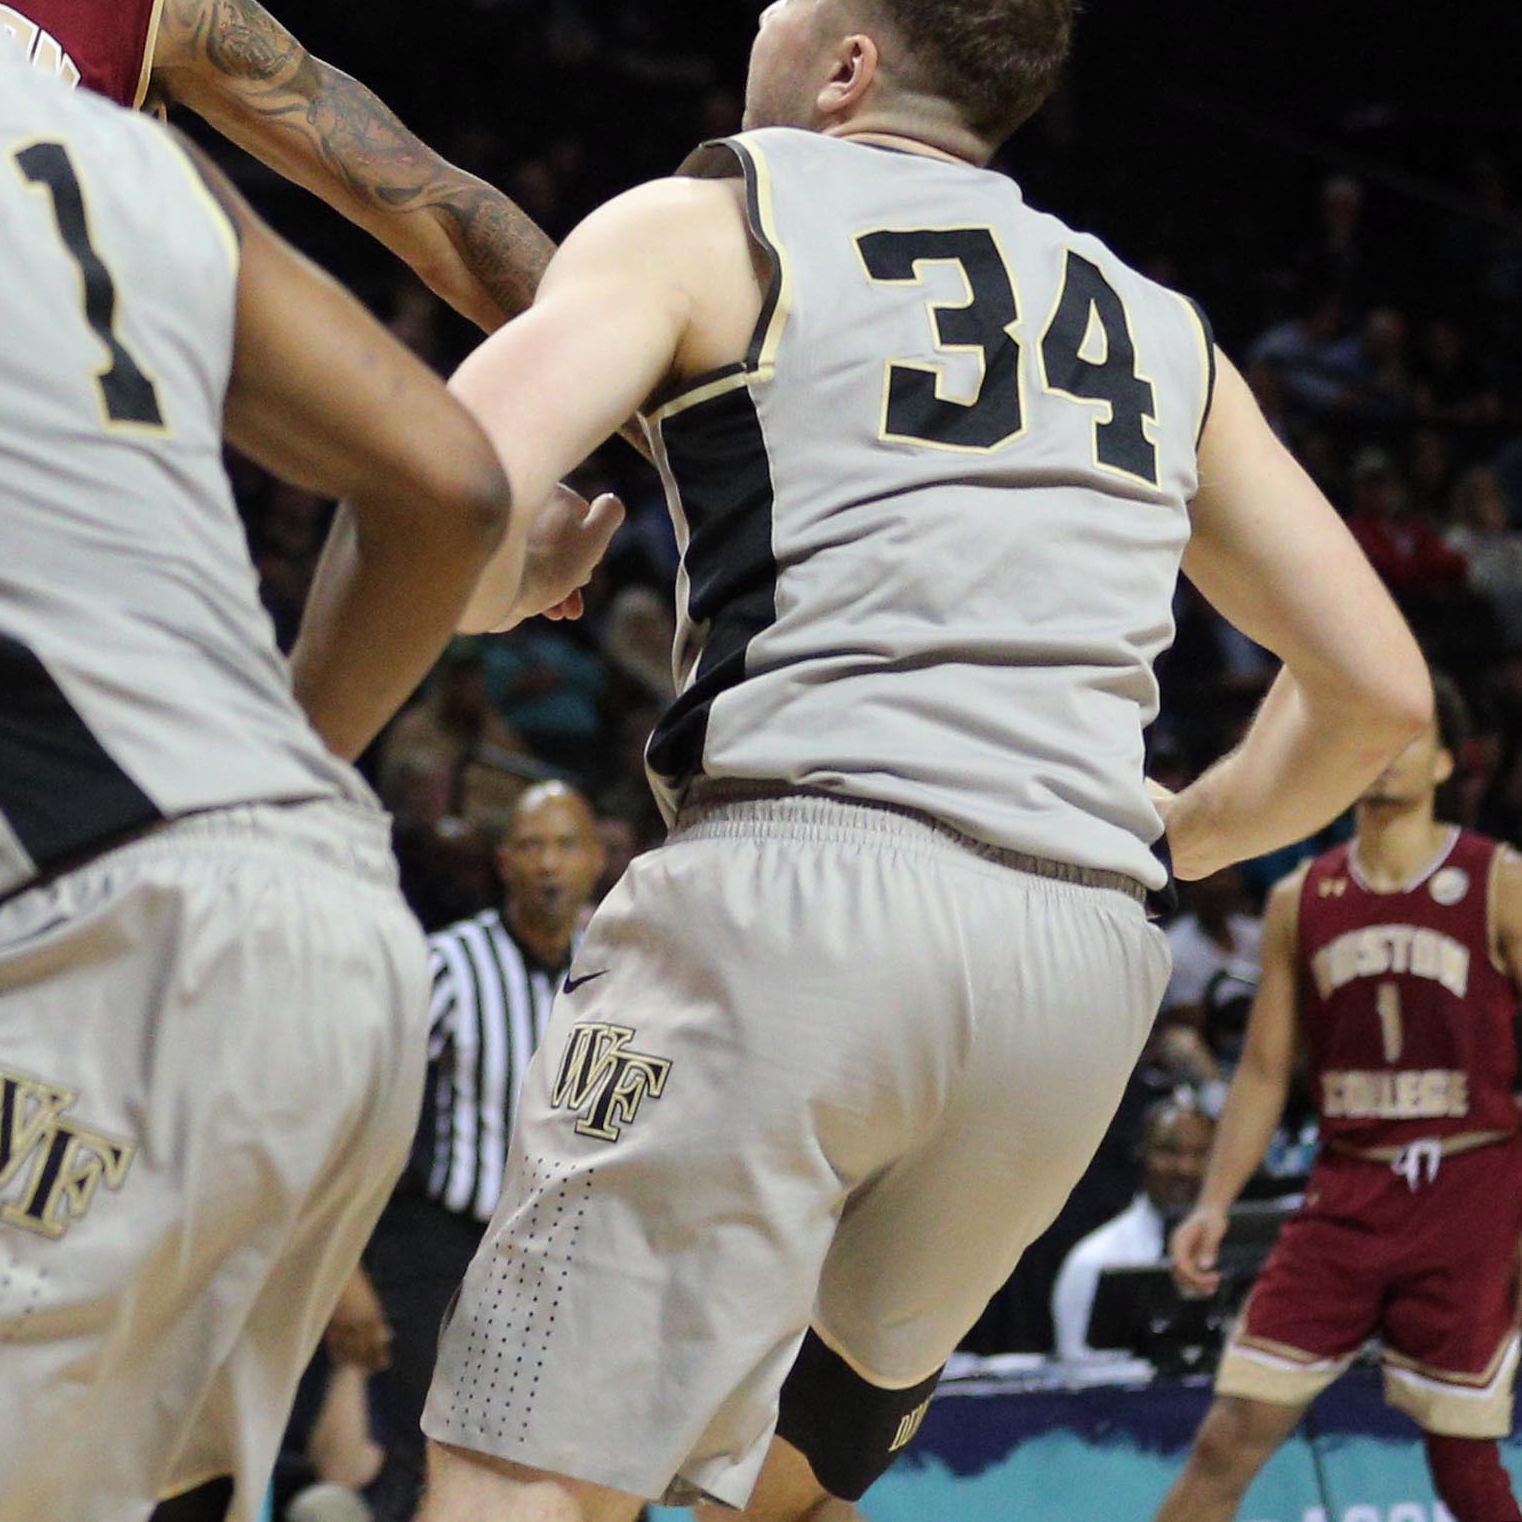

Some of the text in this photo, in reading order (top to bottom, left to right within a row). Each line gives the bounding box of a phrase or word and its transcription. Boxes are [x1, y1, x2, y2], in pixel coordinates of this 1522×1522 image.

[9, 133, 173, 435] 1
[852, 222, 1161, 493] 34
[550, 1020, 674, 1143] WF
[1376, 982, 1404, 1065] 1
